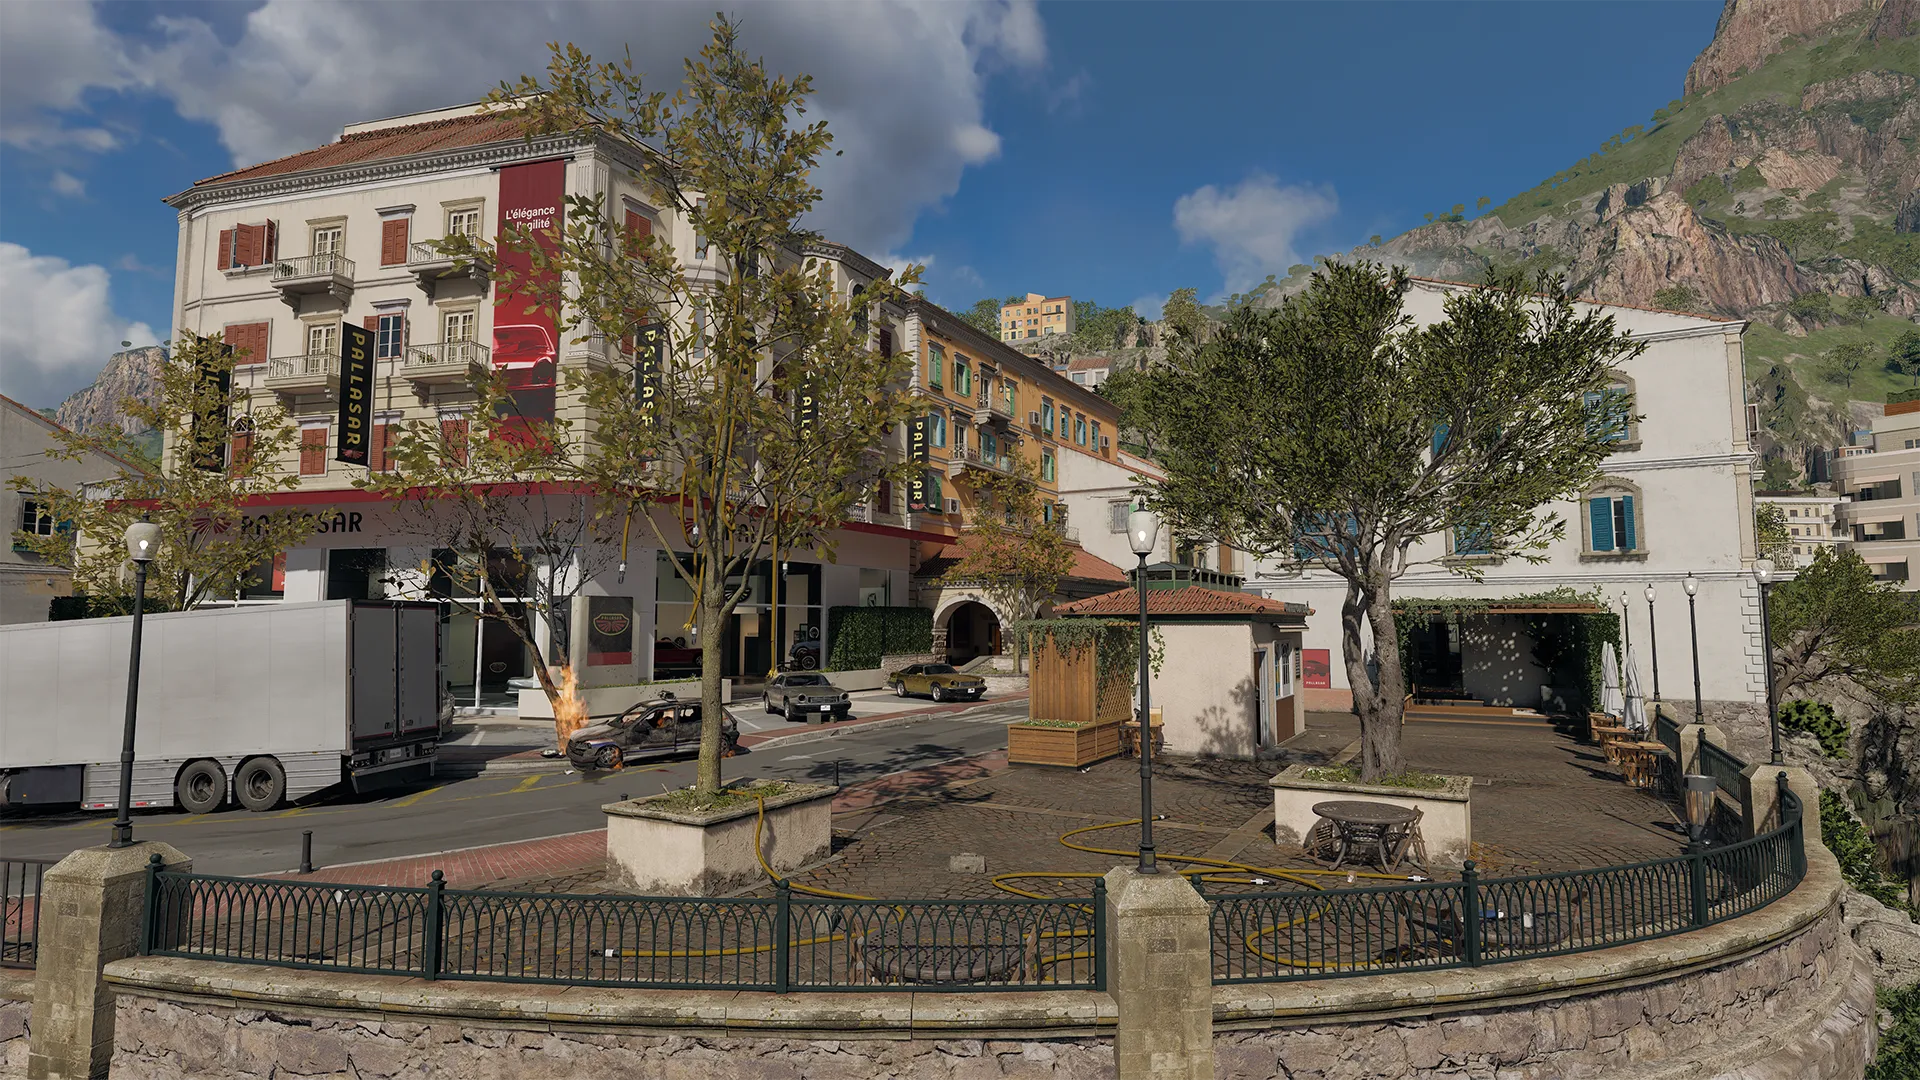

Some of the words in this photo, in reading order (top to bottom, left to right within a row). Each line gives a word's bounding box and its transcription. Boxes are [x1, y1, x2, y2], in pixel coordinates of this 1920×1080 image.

[505, 206, 555, 220] L'élégance
[516, 217, 550, 232] l'gilité
[346, 331, 366, 446] PALLASAR
[913, 421, 924, 501] PALLAR
[240, 511, 363, 537] PASAR
